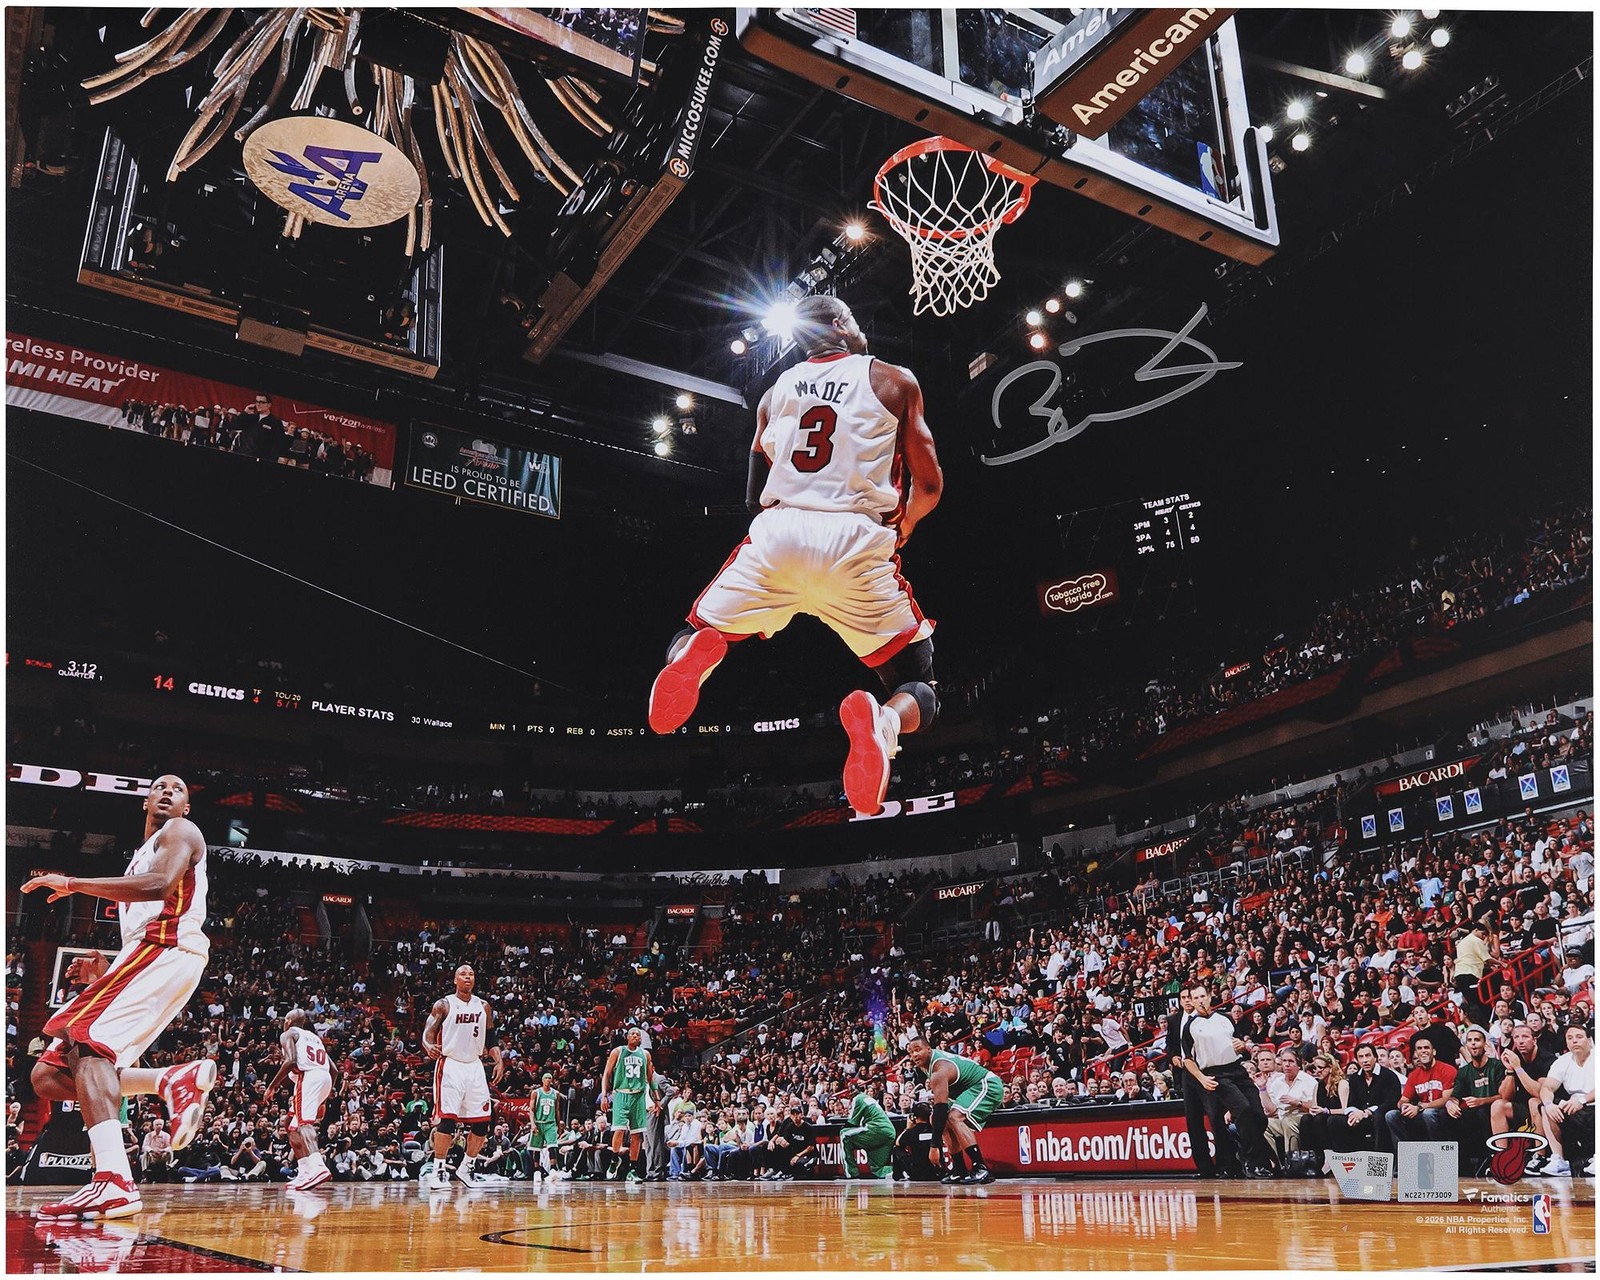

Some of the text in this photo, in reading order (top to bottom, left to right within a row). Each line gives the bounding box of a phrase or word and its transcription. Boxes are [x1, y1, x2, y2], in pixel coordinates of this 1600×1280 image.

[677, 34, 722, 159] MICCOSUKEE.COM
[334, 173, 356, 201] ARENA
[70, 350, 160, 382] Provider
[47, 368, 126, 394] HEAT
[795, 380, 848, 404] WADE
[323, 413, 361, 429] verizon
[791, 405, 838, 473] 3
[412, 466, 457, 490] LEED
[451, 464, 521, 489] IS PROUD TO BE
[1143, 493, 1190, 510] TEAM STATS
[1133, 511, 1194, 531] 3PM 3 2
[1135, 523, 1195, 543] 3PA 4 4
[1165, 540, 1176, 549] 75
[1049, 578, 1101, 602] Tobacco Free
[1064, 590, 1092, 606] Florida
[58, 669, 96, 680] QUARTER
[68, 660, 97, 674] 3:12
[153, 674, 175, 691] 14
[188, 682, 245, 701] CELTICS
[253, 688, 262, 696] TF
[253, 696, 260, 704] 4
[312, 701, 394, 721] PLAYER STATS
[423, 717, 453, 728] Wallace
[489, 722, 505, 730] MIN
[527, 725, 544, 733] PTS
[549, 726, 555, 734] 0
[566, 727, 584, 735] REB
[590, 728, 595, 736] 0
[607, 728, 633, 736] ASSTS
[753, 718, 800, 732] CELTICS
[10, 763, 153, 797] DE
[1399, 761, 1464, 792] BACARDI
[322, 895, 352, 904] BACARDI
[455, 1011, 482, 1024] HEAT
[473, 1026, 479, 1038] 5
[306, 1045, 326, 1065] 50
[625, 1065, 640, 1078] 34
[1404, 1191, 1453, 1199] NC221773009
